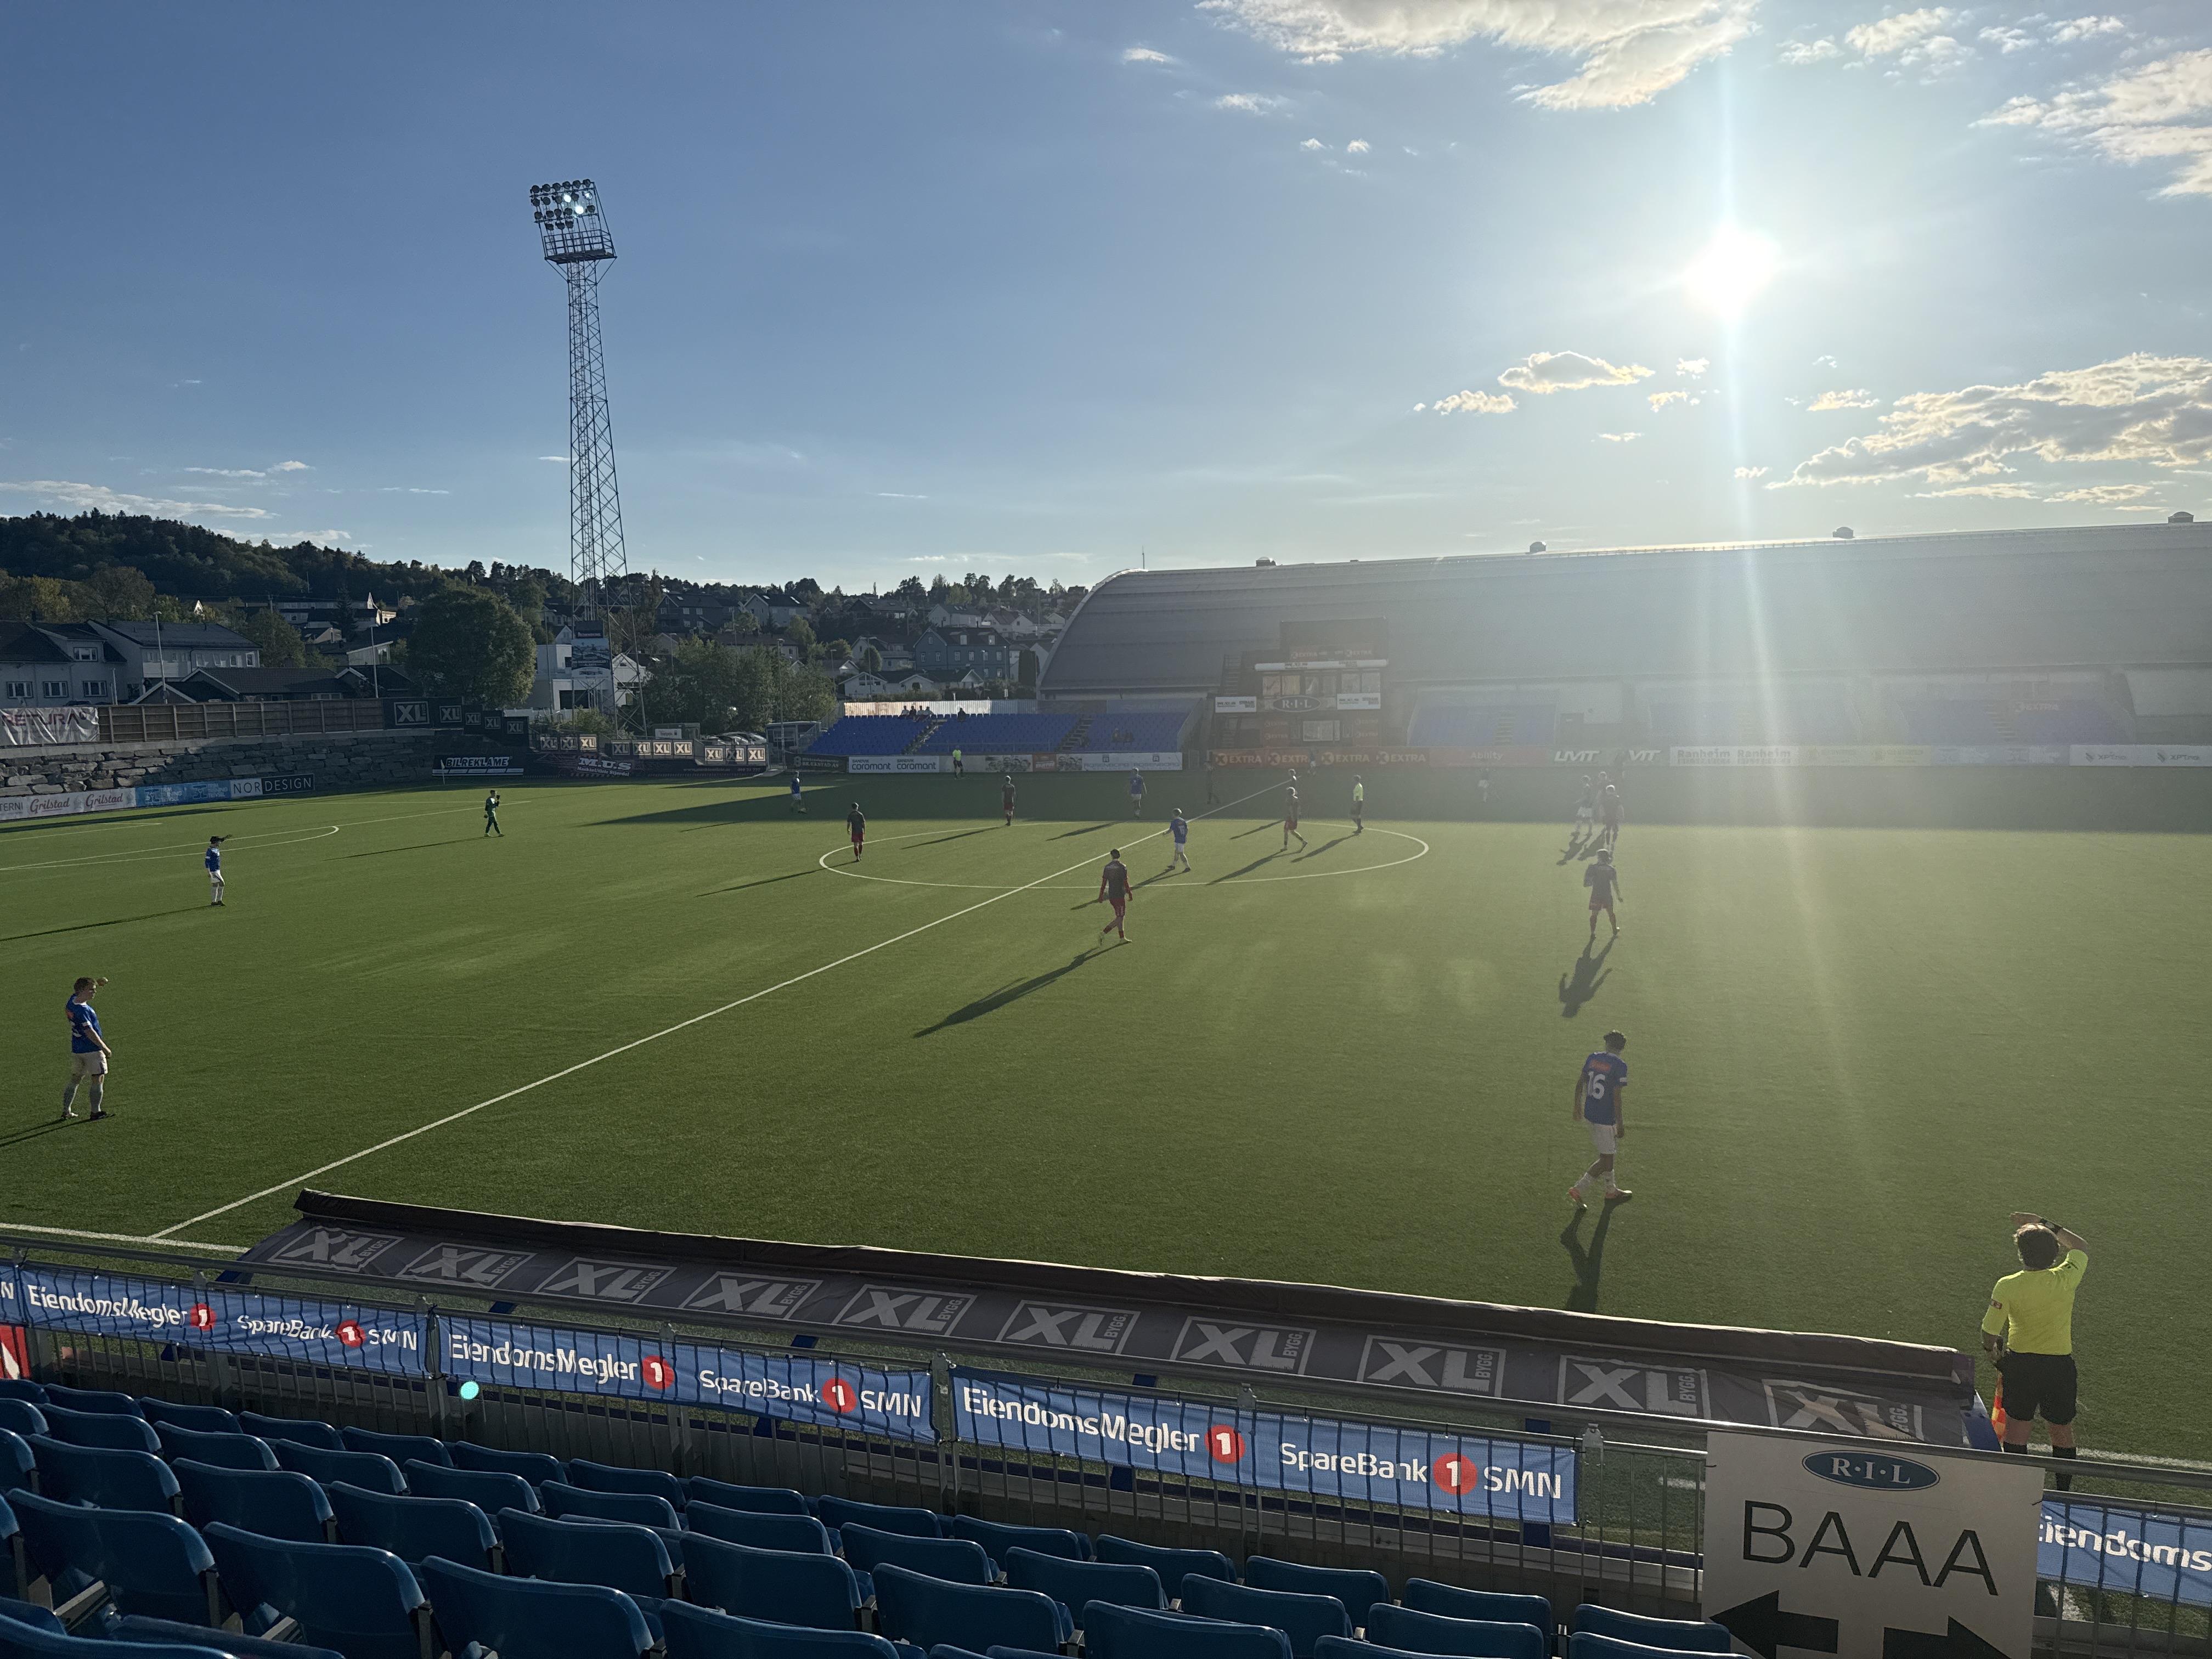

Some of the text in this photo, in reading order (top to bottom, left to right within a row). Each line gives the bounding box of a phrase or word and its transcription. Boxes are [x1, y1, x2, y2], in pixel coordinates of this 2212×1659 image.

[397, 704, 426, 723] XL
[441, 708, 461, 722] XL
[466, 714, 480, 724] XL
[486, 718, 500, 728] XL
[509, 723, 523, 732] XL
[445, 757, 510, 768] BILREKLAME
[1229, 755, 1262, 764] EXTRA
[1282, 755, 1309, 763] EXTR
[1335, 754, 1370, 763] EXTRA
[1391, 754, 1427, 762] EXTRA
[30, 797, 70, 814] Grilstad
[86, 793, 123, 809] Grilstad
[1588, 1071, 1605, 1099] 16
[281, 1231, 372, 1264] XL
[410, 1247, 504, 1282] XL
[543, 1263, 642, 1299] XL
[691, 1278, 789, 1316] XL
[28, 1284, 188, 1328] EiendomsMegler
[842, 1291, 946, 1332] XL
[237, 1314, 335, 1340] SpareBank
[369, 1329, 417, 1351] SMN
[1006, 1307, 1115, 1351] XL
[1180, 1323, 1295, 1370] XL
[448, 1334, 638, 1384] EiendomsMegler
[1367, 1342, 1489, 1392] XL
[699, 1369, 821, 1403] SpareBank
[860, 1390, 922, 1418] SMN
[1568, 1363, 1698, 1417] XL
[963, 1386, 1232, 1455] EiendomsMegler 1
[1279, 1442, 1561, 1499] SpareBank 1 SMN
[1743, 1500, 1998, 1596] BAAA
[2038, 1513, 2212, 1572] iendoms
